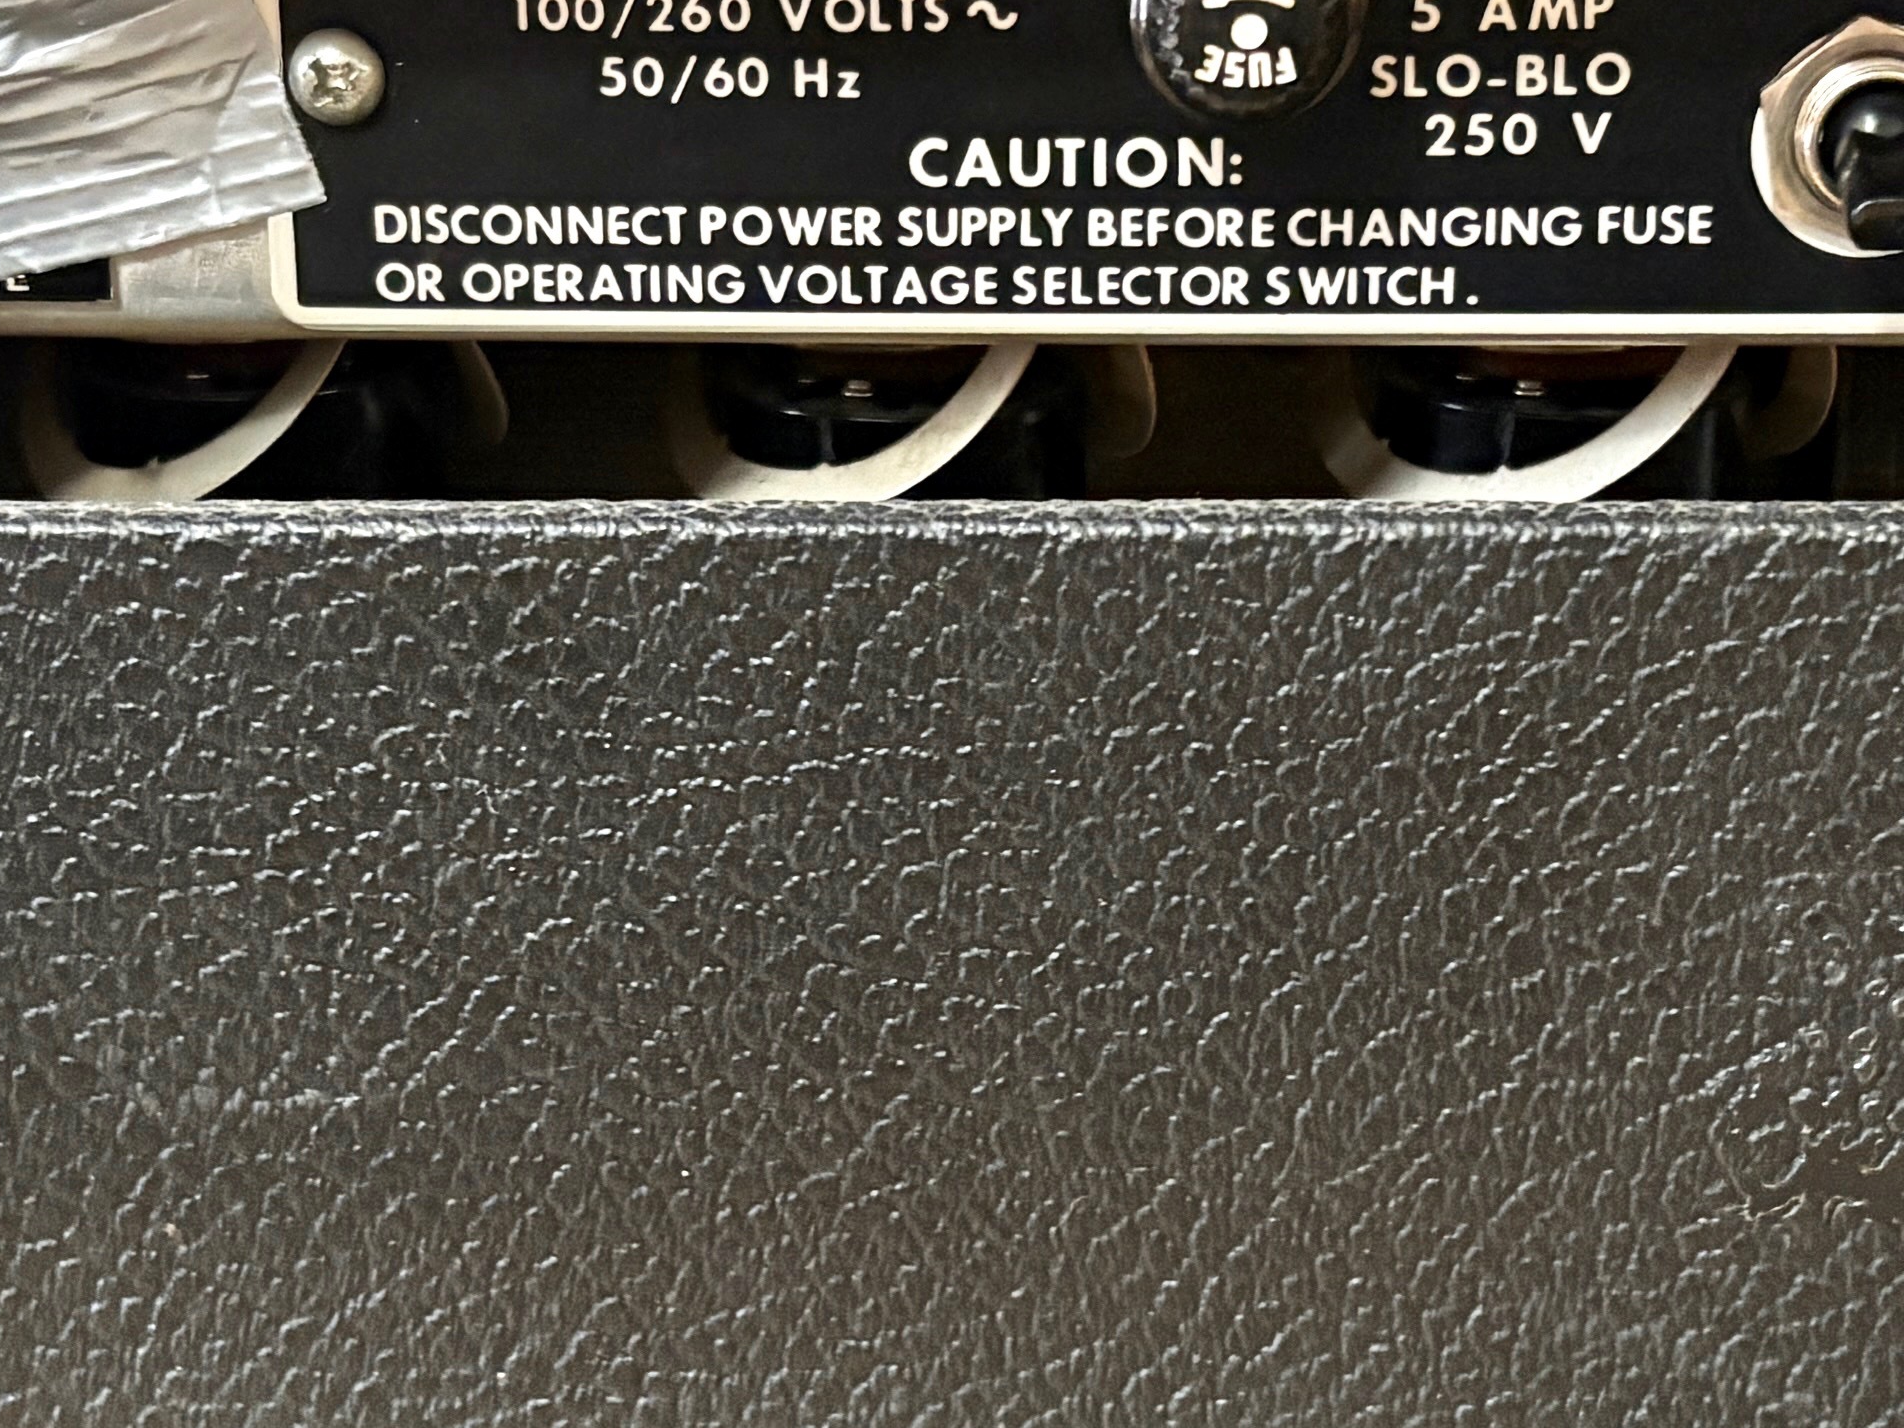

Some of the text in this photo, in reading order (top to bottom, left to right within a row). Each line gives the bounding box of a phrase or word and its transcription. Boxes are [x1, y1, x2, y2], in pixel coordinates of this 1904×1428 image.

[598, 56, 862, 105] 50/60 Hz
[1194, 43, 1298, 89] FUSE
[1370, 51, 1633, 99] SLO-BLO
[1423, 110, 1613, 158] 250 V
[907, 135, 1244, 189] CAUTION:
[373, 203, 1715, 249] DISCONNECT POWER SUPPLY BEFORE CHANGING FUSE
[375, 262, 1480, 308] OR OPERATING VOLTAGE SELECTOR SWITCH.
